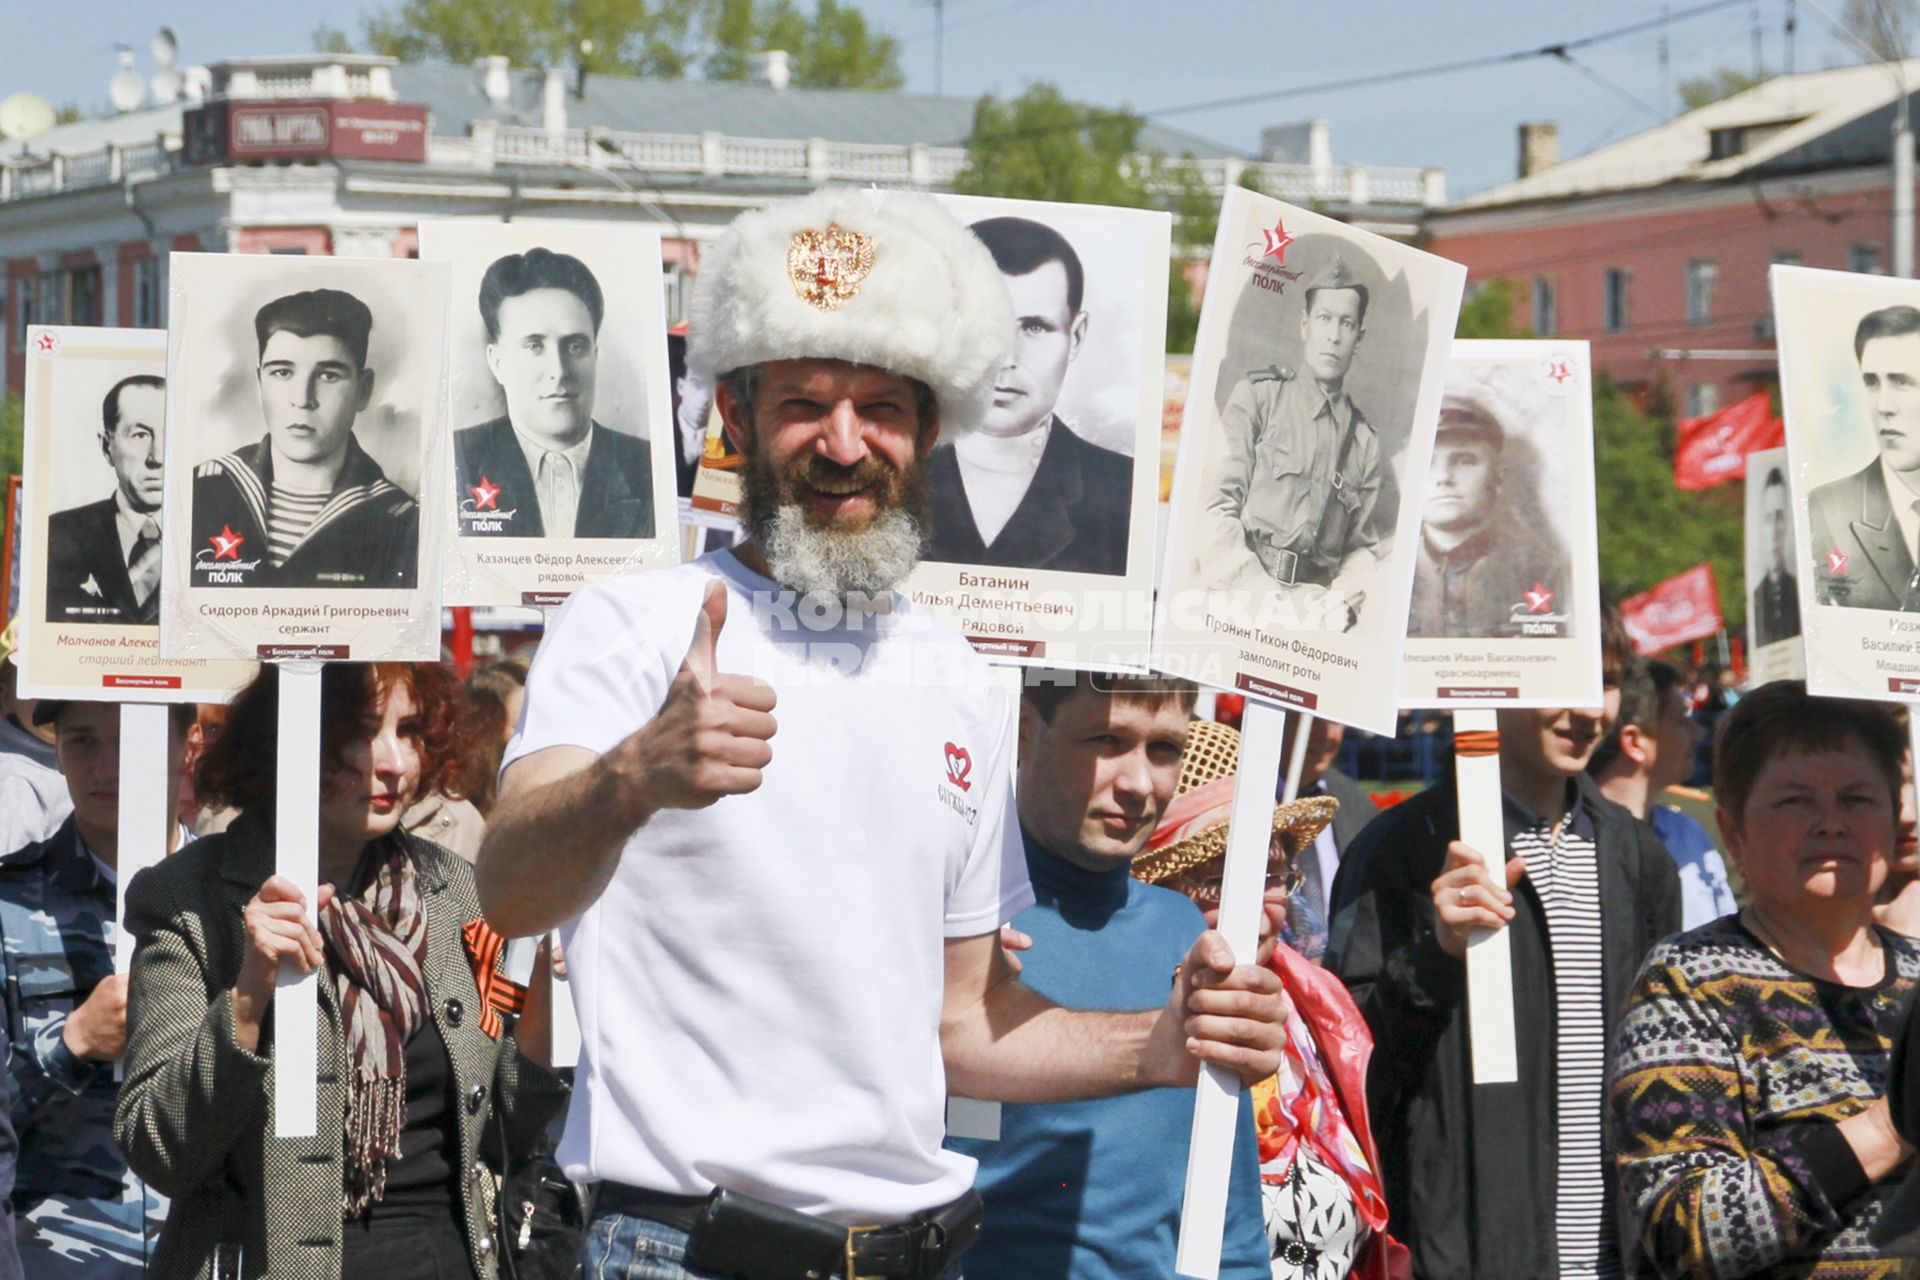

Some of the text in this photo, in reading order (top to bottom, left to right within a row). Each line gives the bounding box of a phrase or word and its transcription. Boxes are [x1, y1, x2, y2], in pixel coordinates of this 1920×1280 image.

[1252, 273, 1285, 295] ПОЛК
[472, 520, 503, 532] ПОЛК
[477, 553, 532, 566] Казанцев
[534, 553, 573, 567] Фёдор
[208, 572, 243, 583] ПОЛК
[538, 571, 585, 583] рядовой
[959, 572, 1029, 590] Батанин
[912, 591, 1074, 616] Илья Дементьевич
[199, 604, 410, 618] Сидоров Аркадий Григорьевич
[278, 625, 331, 635] сержант
[962, 618, 1024, 634] Рядовой
[1522, 624, 1557, 634] ПОЛК
[57, 634, 116, 647] Молчанов
[1205, 614, 1359, 670] Пронин Тихон Фёдорович
[1862, 636, 1913, 653] Василий
[79, 654, 207, 668] старший лейтенант
[1238, 649, 1321, 682] замполит роты
[1454, 653, 1484, 663] Иван
[1487, 653, 1557, 664] Васильевич
[1434, 669, 1521, 680] красноармеец
